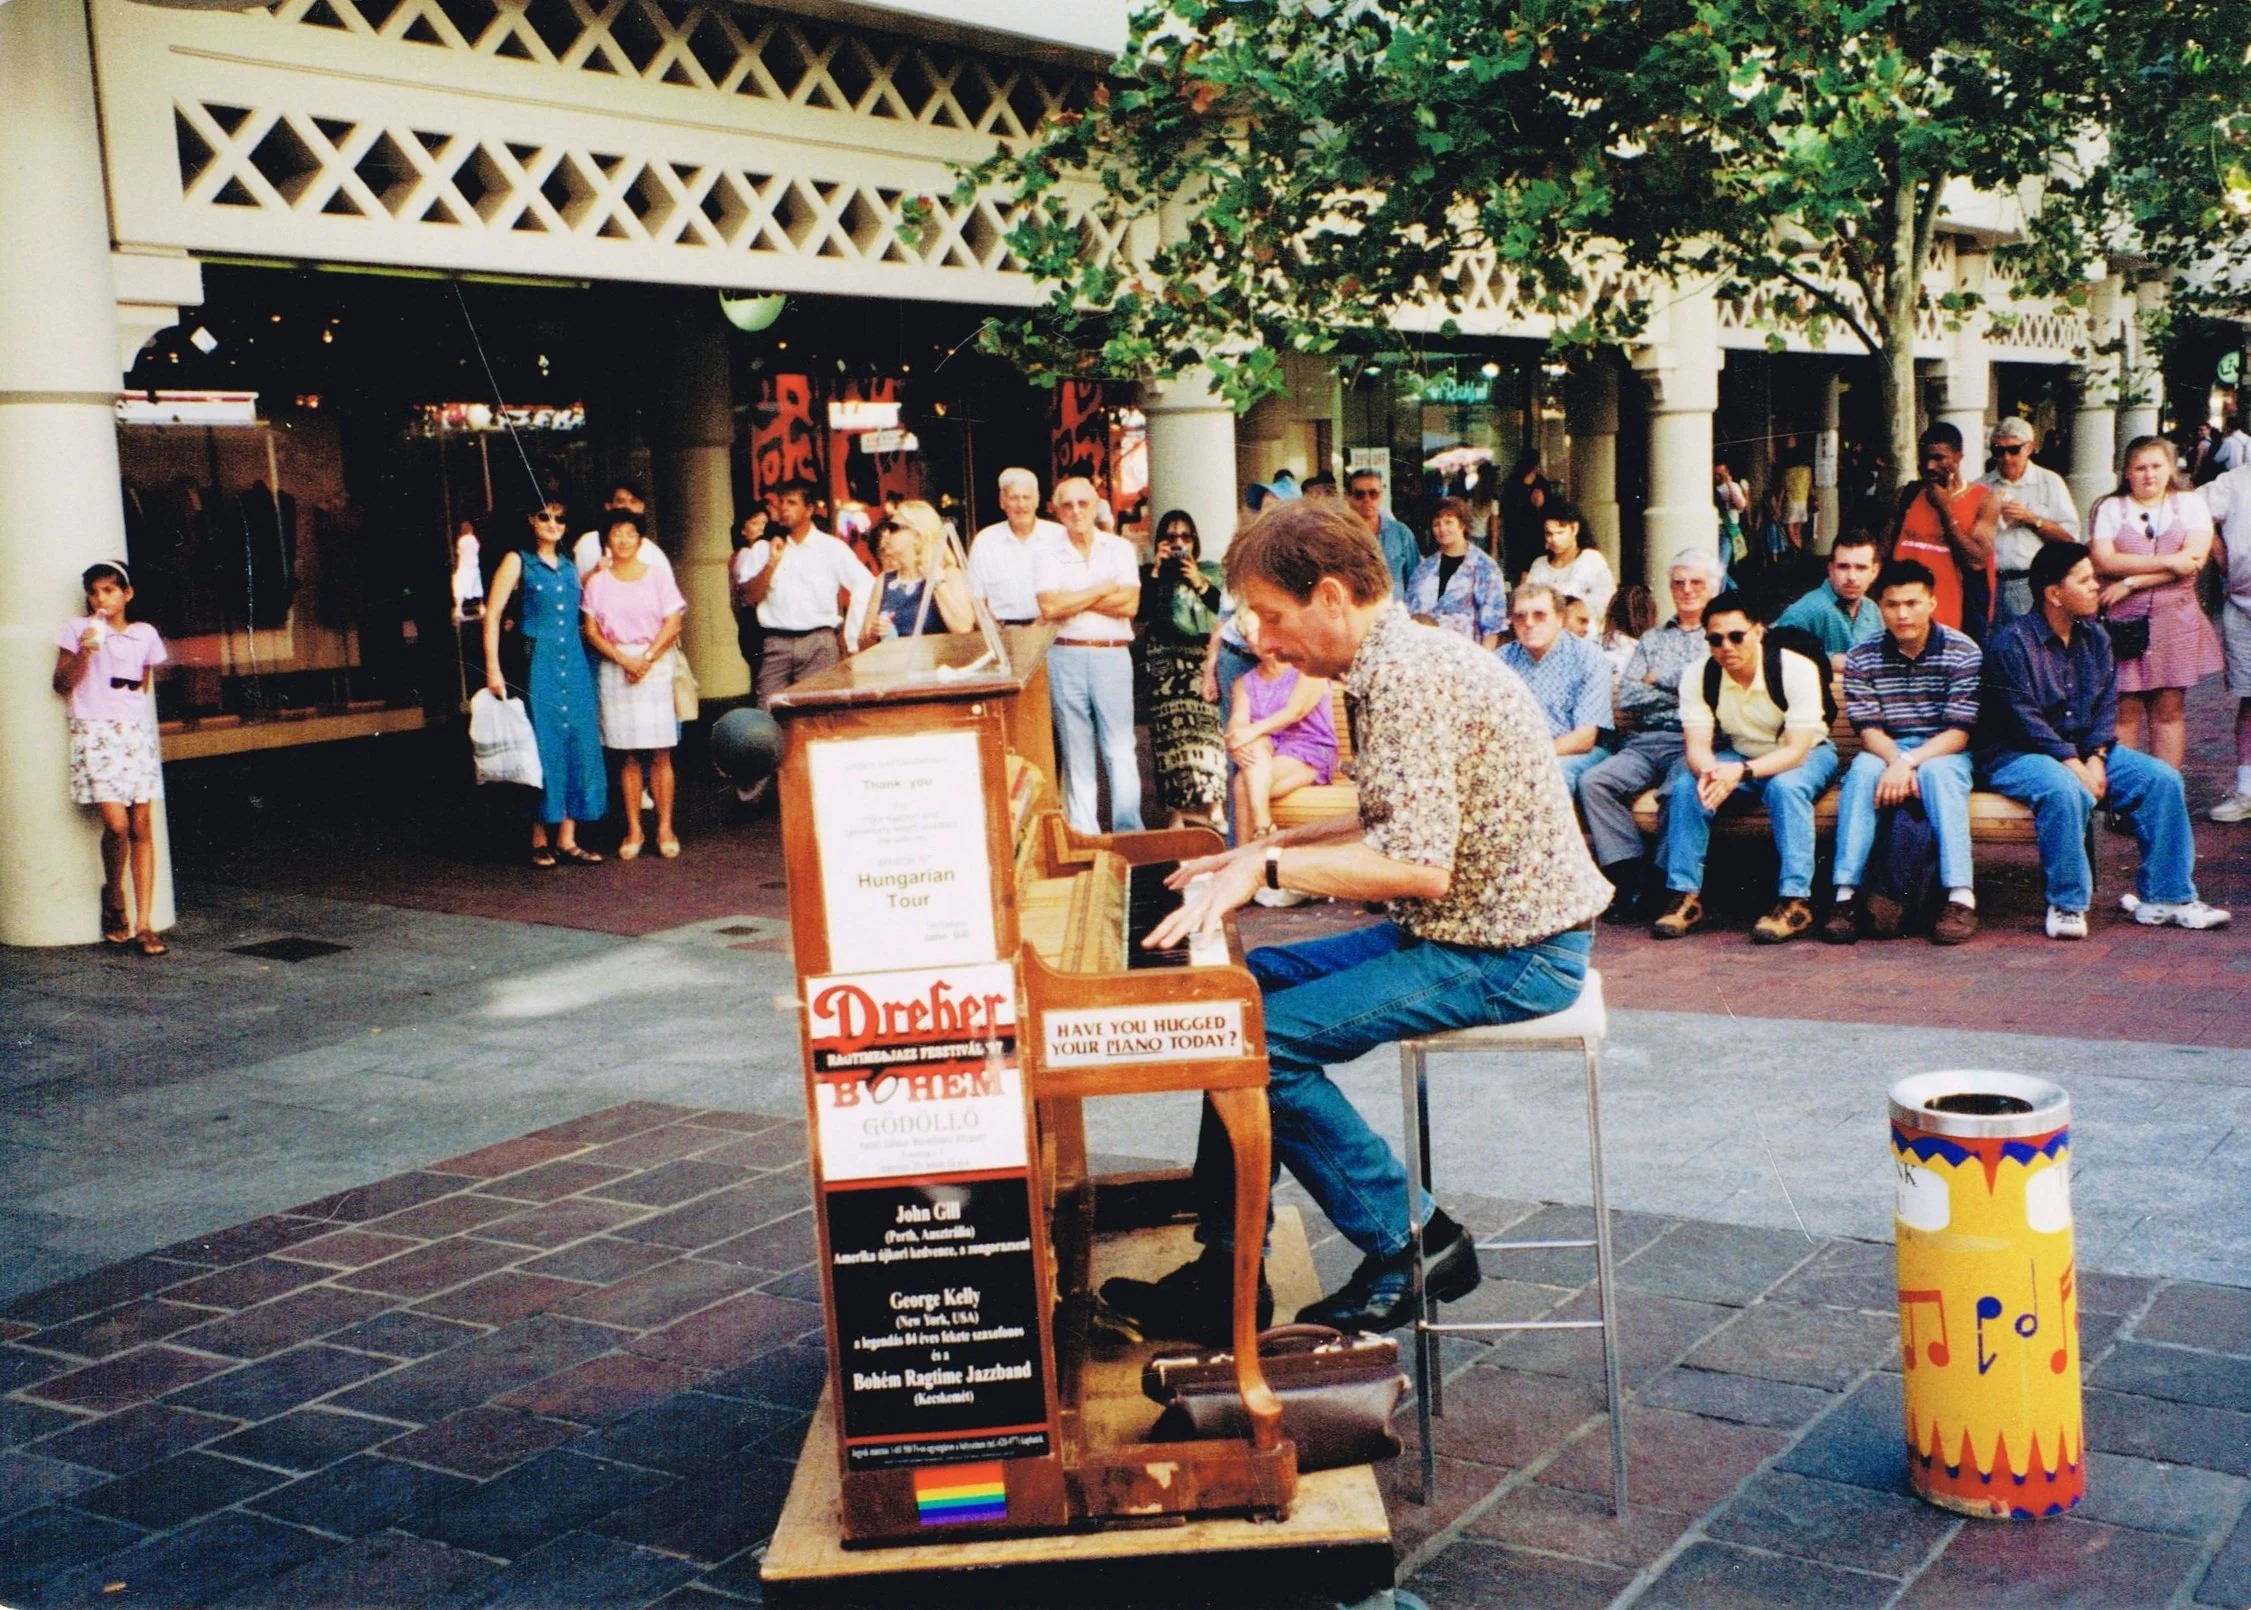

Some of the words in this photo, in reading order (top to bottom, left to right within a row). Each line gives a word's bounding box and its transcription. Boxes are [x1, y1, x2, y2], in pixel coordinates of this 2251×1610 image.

[861, 779, 901, 790] Thank
[909, 778, 934, 790] you
[857, 869, 956, 890] Hungarian
[886, 892, 931, 909] Tour
[813, 979, 1008, 1050] Dreher
[1057, 1021, 1104, 1038] HAVE
[1110, 1019, 1148, 1035] YOU
[1153, 1015, 1226, 1032] HUGGED
[1052, 1040, 1100, 1056] YOUR
[1105, 1037, 1163, 1055] PIANO
[1169, 1031, 1238, 1050] TODAY?
[895, 1204, 931, 1224] John
[933, 1201, 961, 1222] Gill
[884, 1228, 920, 1245] (Perth,
[833, 1250, 877, 1265] Amerika
[910, 1245, 958, 1260] kedvence,
[889, 1291, 941, 1312] George
[943, 1286, 981, 1309] Kelly
[895, 1314, 921, 1330] (New
[923, 1312, 951, 1327] York,
[952, 1310, 980, 1326] USA)
[853, 1339, 861, 1350] a
[861, 1333, 904, 1352] legendás
[904, 1332, 918, 1346] 84
[918, 1331, 940, 1345] éves
[941, 1329, 971, 1344] fekete
[930, 1348, 942, 1362] és
[943, 1350, 950, 1361] a
[853, 1370, 902, 1391] Bohém
[904, 1367, 963, 1390] Ragtime
[966, 1360, 1033, 1384] Jazzband
[913, 1389, 975, 1407] (Kecskemét)
